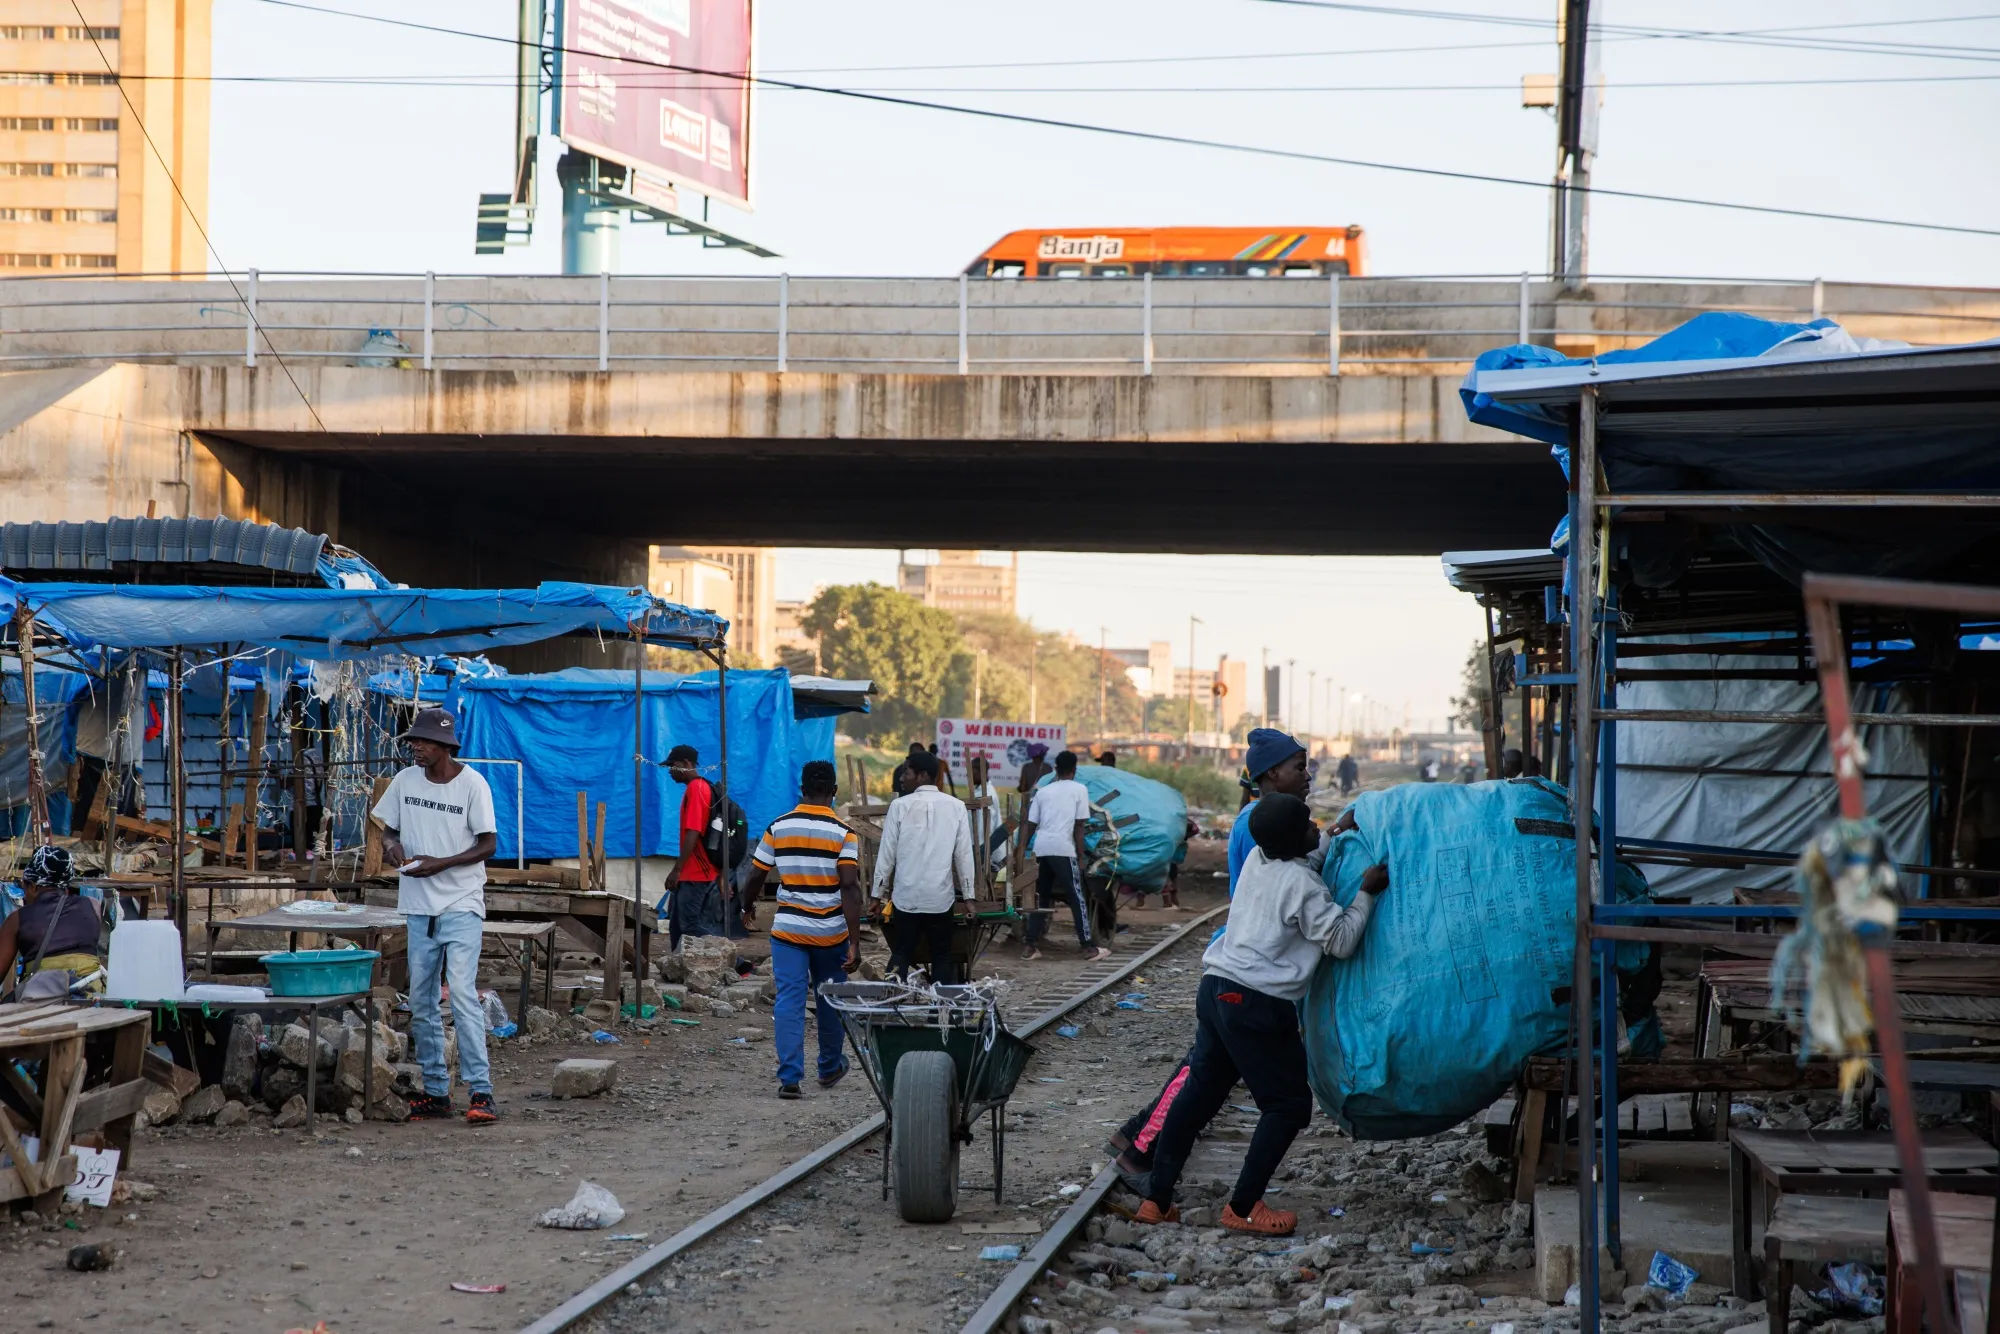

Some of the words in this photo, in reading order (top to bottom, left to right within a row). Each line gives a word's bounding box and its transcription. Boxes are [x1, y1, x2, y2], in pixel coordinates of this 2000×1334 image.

[965, 724, 1061, 740] WARNING!!
[404, 796, 421, 806] NEITHER
[421, 799, 437, 810] ENEMY
[437, 802, 446, 812] NOR
[1513, 846, 1530, 899] PRODUCT
[1486, 898, 1500, 930] NETT
[1523, 906, 1535, 923] OF
[1537, 891, 1556, 931] WHITE
[1548, 937, 1569, 980] SUGAR
[1528, 931, 1549, 978] ZAMBIA
